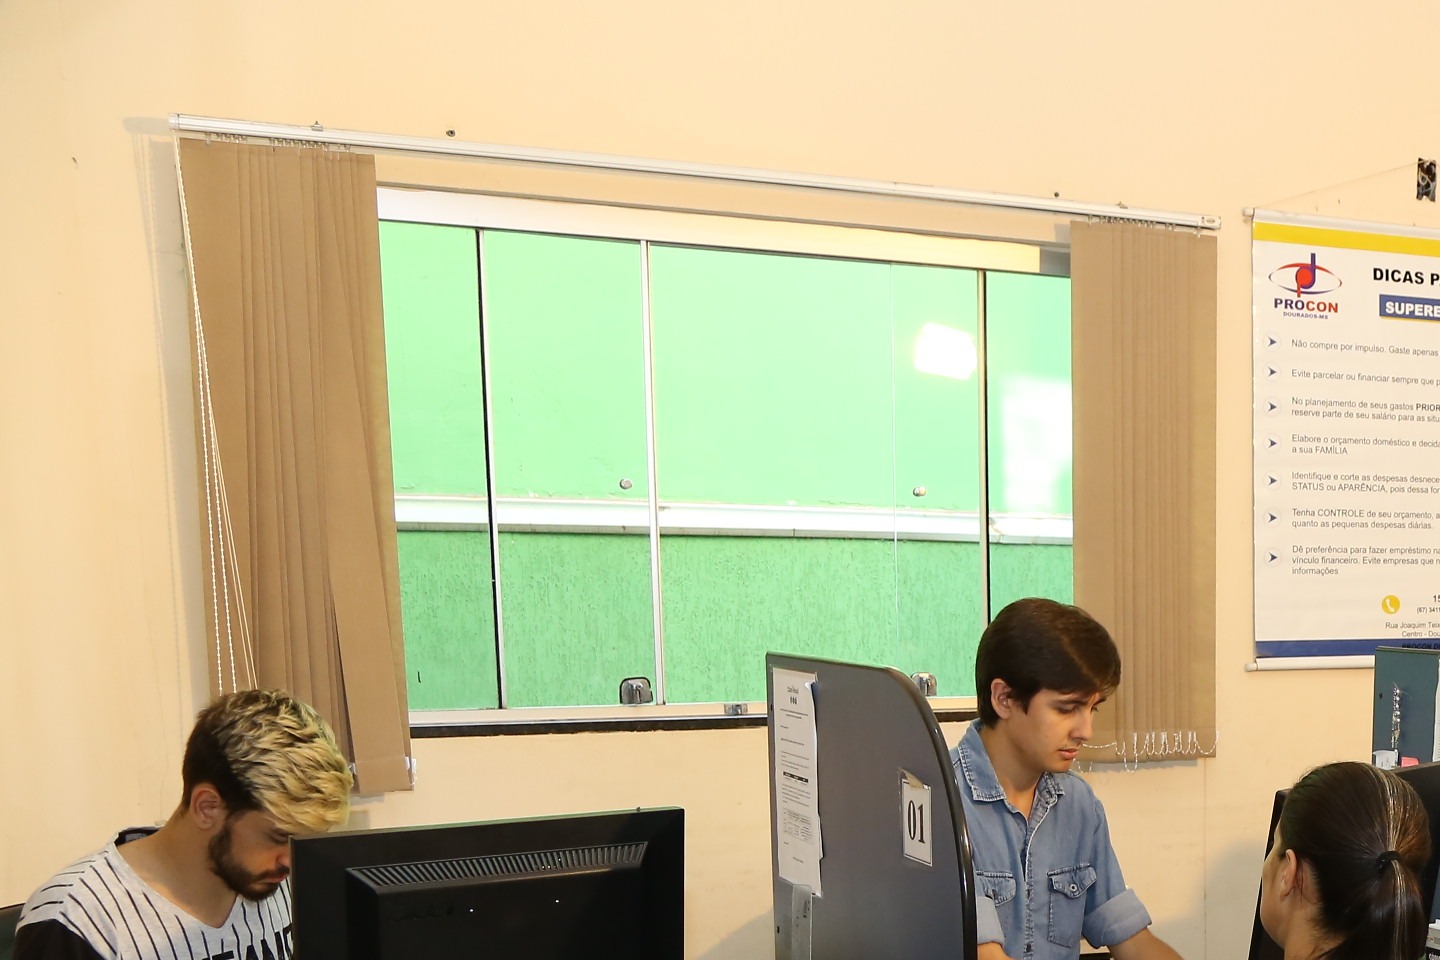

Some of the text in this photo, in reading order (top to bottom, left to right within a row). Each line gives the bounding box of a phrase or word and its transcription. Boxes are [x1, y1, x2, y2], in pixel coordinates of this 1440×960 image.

[1372, 267, 1424, 284] DICAS
[1274, 298, 1338, 313] PROCON
[1291, 339, 1307, 348] Não
[1309, 341, 1338, 350] compre
[1340, 343, 1353, 352] por
[1388, 345, 1410, 354] Gaste
[1412, 348, 1438, 356] apenas
[1291, 368, 1310, 378] Evite
[1313, 371, 1343, 379] parcelar
[1358, 372, 1388, 382] financiar
[1392, 376, 1418, 384] sempre
[1420, 378, 1434, 386] que
[1291, 396, 1303, 405] No
[1304, 397, 1356, 408] planejamento
[1358, 400, 1368, 408] de
[1389, 402, 1415, 411] gastos
[1322, 410, 1341, 418] parte
[1344, 410, 1353, 418] de
[1372, 412, 1396, 420] salário
[1398, 414, 1414, 422] para
[1291, 434, 1321, 443] Elabore
[1330, 436, 1370, 445] orçamento
[1372, 437, 1410, 446] doméstico
[1314, 445, 1348, 454] FAMÍLIA
[1292, 471, 1331, 481] Identifique
[1340, 473, 1359, 481] corte
[1372, 474, 1407, 483] despesas
[1291, 482, 1324, 491] STATUS
[1389, 484, 1405, 494] pois
[1406, 485, 1428, 493] dessa
[1291, 508, 1315, 516] Tenha
[1317, 508, 1364, 517] CONTROLE
[1366, 510, 1376, 518] de
[1291, 519, 1318, 528] quanto
[1331, 521, 1368, 529] pequenas
[1370, 520, 1406, 529] despesas
[1292, 544, 1303, 553] Dê
[1305, 545, 1347, 554] preferência
[1349, 547, 1366, 555] para
[1368, 545, 1387, 554] fazer
[1389, 546, 1431, 555] empréstimo
[1292, 555, 1319, 564] vínculo
[1362, 556, 1381, 564] Evite
[1420, 558, 1434, 566] que
[1291, 566, 1339, 576] informações
[907, 800, 926, 844] 01
